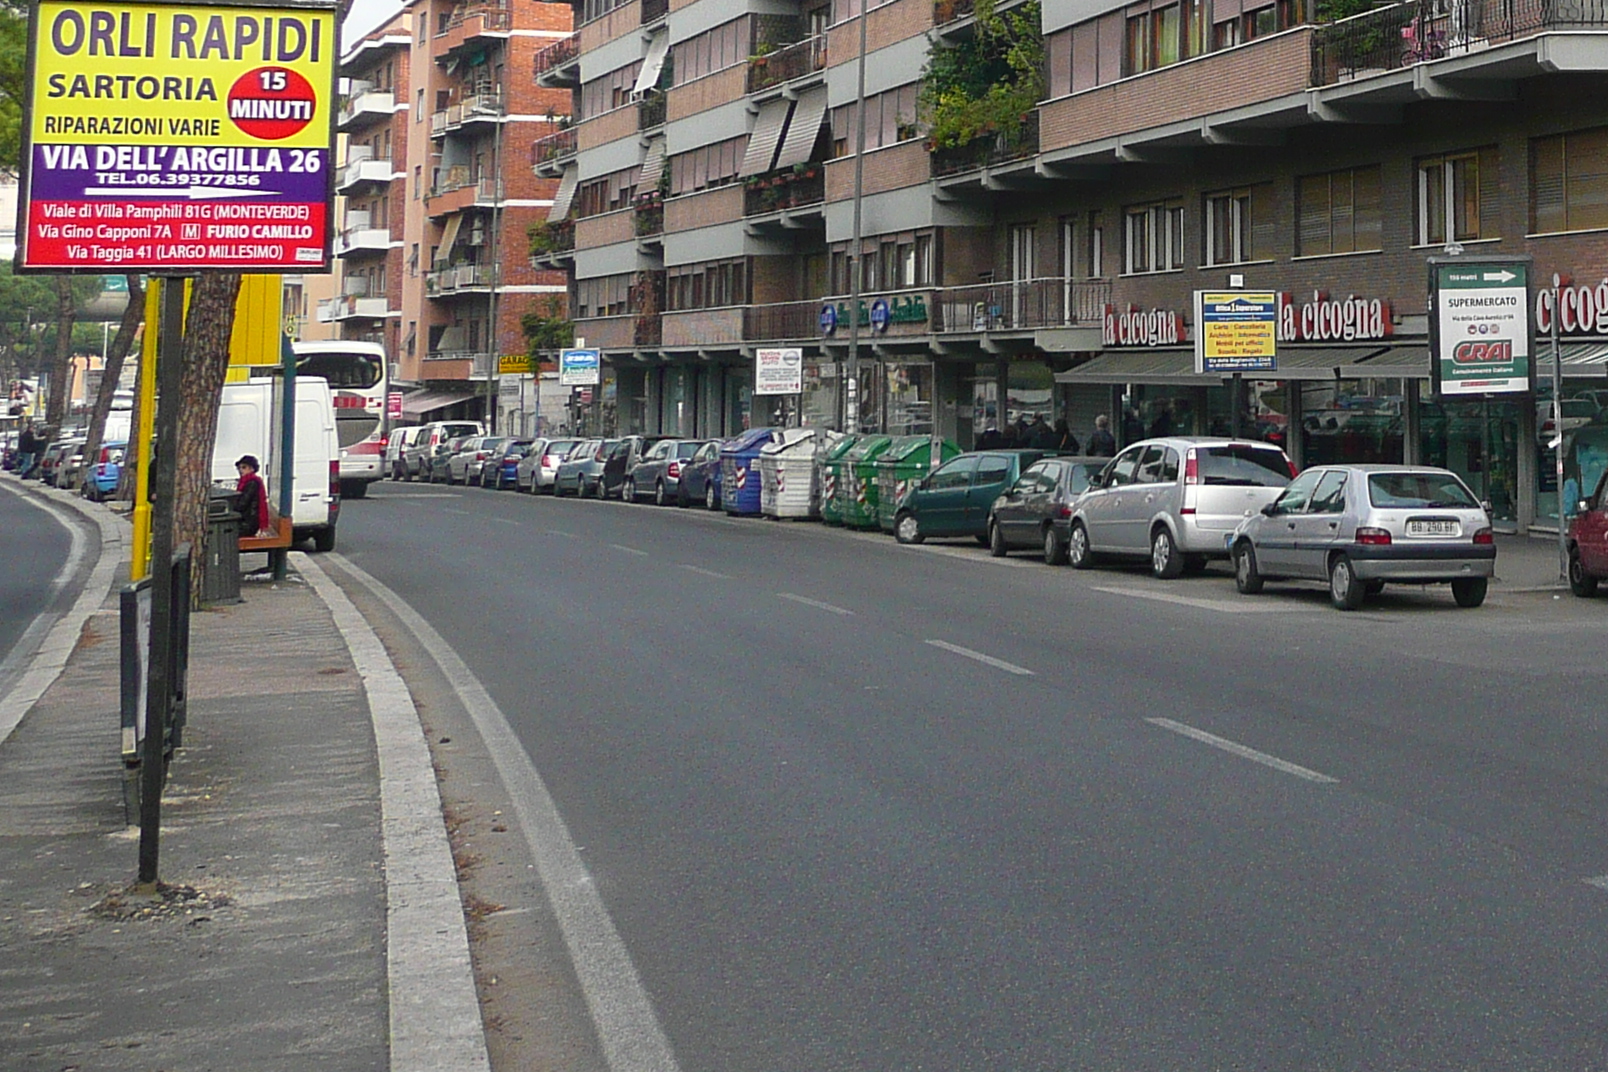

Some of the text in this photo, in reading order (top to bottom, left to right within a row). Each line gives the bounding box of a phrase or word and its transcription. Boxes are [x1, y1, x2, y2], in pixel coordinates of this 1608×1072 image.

[52, 9, 321, 62] ORLI RAPIDI
[47, 74, 217, 101] SARTORIA
[260, 71, 286, 90] 15
[231, 99, 311, 119] MINUTI
[45, 116, 220, 136] RIPARAZIONI VARIE
[42, 145, 89, 170] VIA
[288, 150, 321, 173] 26
[95, 173, 261, 185] TEL.06.39377856
[43, 204, 309, 221] Viale di Villa Pamphili 81G (MONTEVERDE)
[38, 224, 59, 238] Via
[62, 224, 93, 238] Gino
[97, 224, 151, 242] Capponi
[154, 225, 172, 238] 7A
[207, 225, 249, 238] FURIO
[252, 225, 312, 238] CAMILLO
[67, 245, 88, 258] Via
[90, 245, 134, 262] Taggia
[136, 245, 151, 258] 41
[157, 245, 205, 260] (LARGO
[209, 245, 283, 260] MILLESIMO)
[1448, 297, 1517, 307] SUPERMERCATO
[1102, 302, 1178, 347] la cicogna
[1277, 289, 1384, 341] la cicogna
[1457, 342, 1511, 361] CRAI
